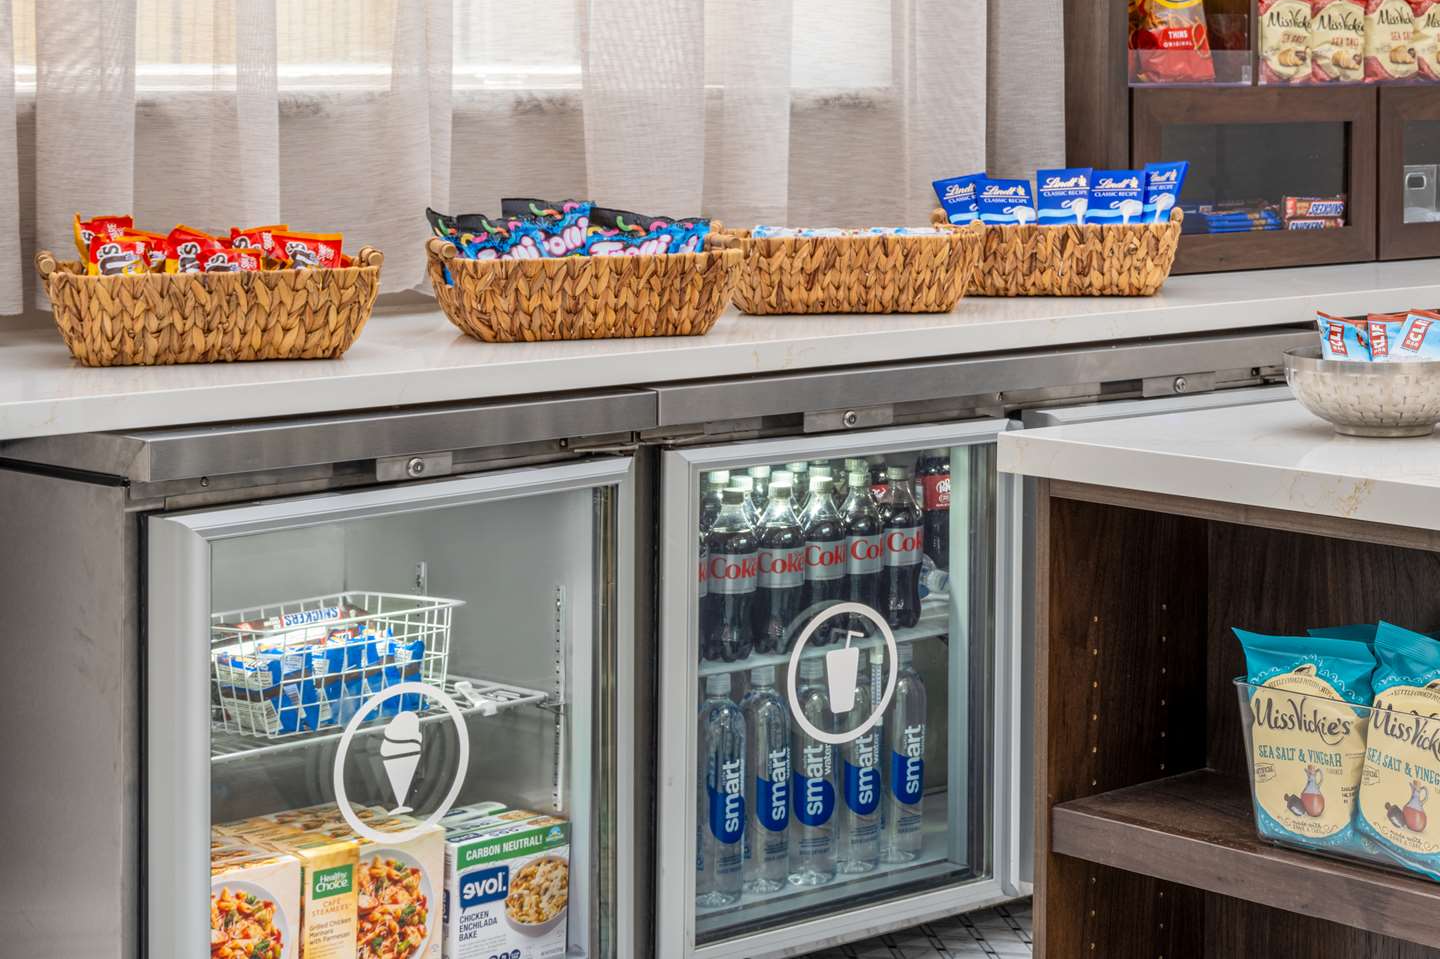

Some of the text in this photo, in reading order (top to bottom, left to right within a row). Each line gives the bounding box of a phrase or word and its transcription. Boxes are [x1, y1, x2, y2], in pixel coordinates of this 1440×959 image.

[850, 539, 883, 560] Co
[887, 528, 922, 552] Cok
[283, 607, 338, 626] SNICKERS
[1288, 696, 1351, 745] Vickie's
[904, 724, 921, 794] smart
[1258, 745, 1343, 767] SEA SALT & VINEGAR
[1382, 753, 1402, 773] SALT
[1404, 763, 1413, 778] &
[804, 744, 823, 816] smart
[856, 734, 873, 805] smart
[722, 758, 740, 833] smart
[769, 748, 786, 821] smart
[466, 835, 543, 861] CARBON NEUTRAL!
[316, 879, 348, 893] Choice
[459, 911, 489, 924] CHICKEN
[459, 917, 498, 933] ENCHILADA
[459, 931, 478, 942] BAKE
